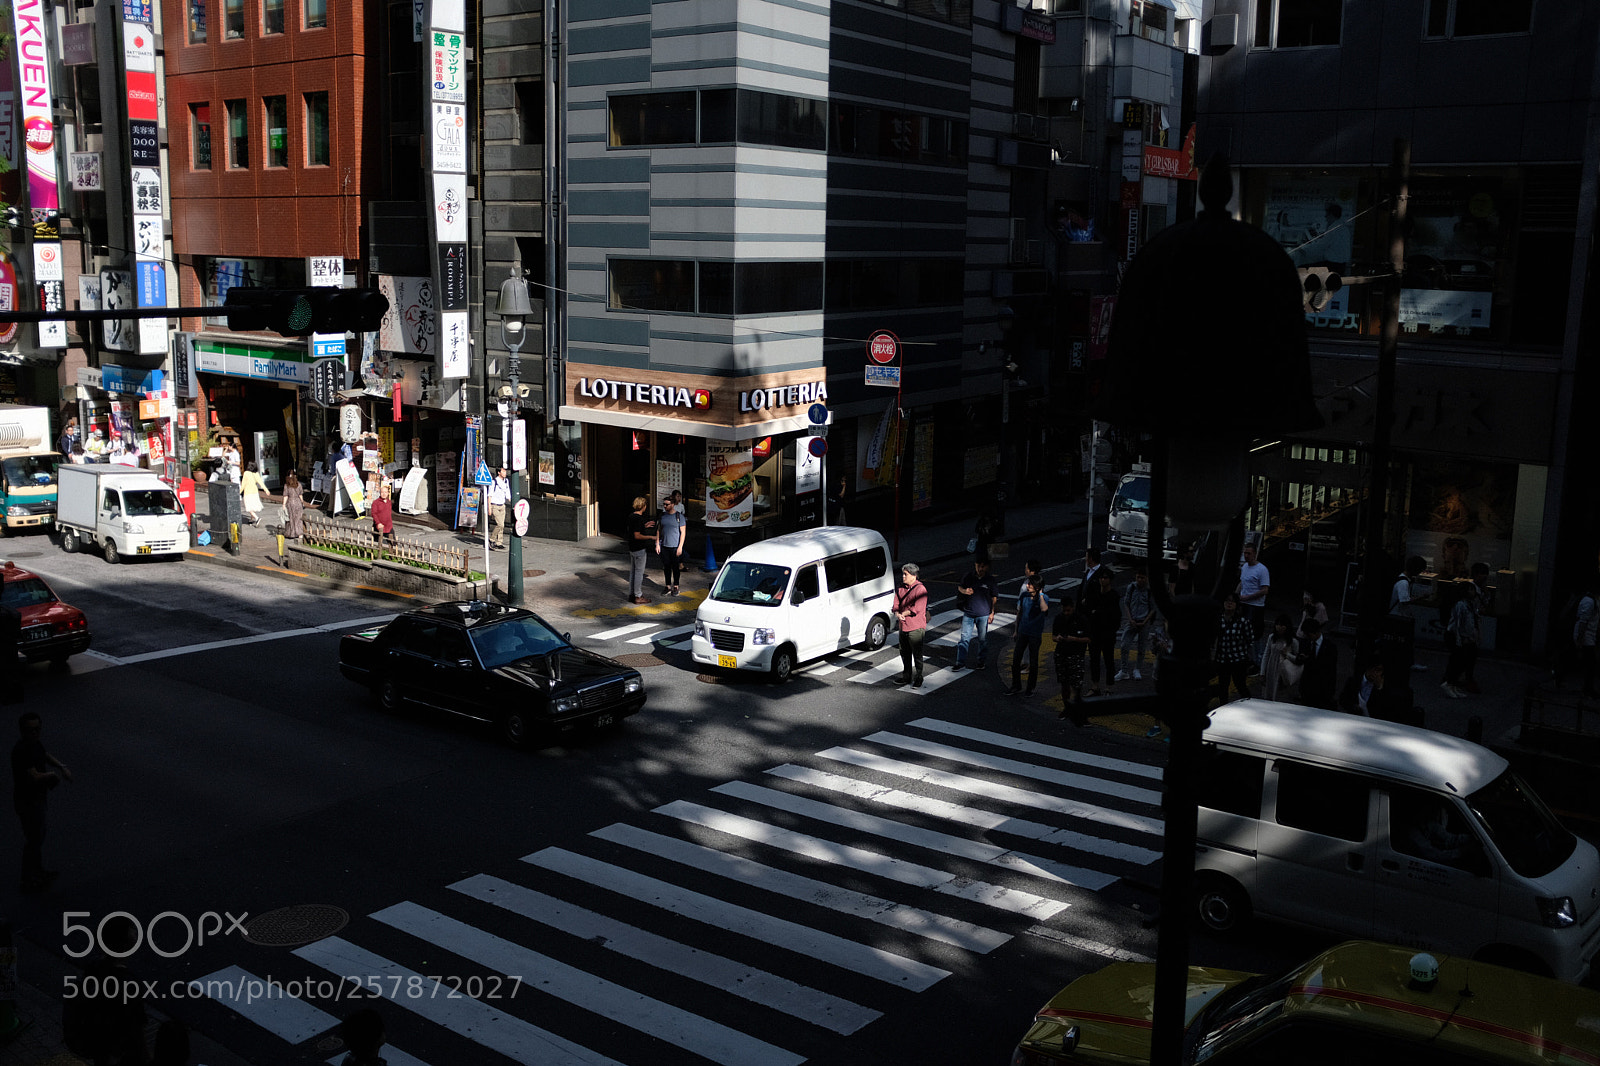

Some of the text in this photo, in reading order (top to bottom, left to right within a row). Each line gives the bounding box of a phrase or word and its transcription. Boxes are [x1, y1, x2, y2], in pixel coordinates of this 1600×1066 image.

[26, 128, 53, 143] 楽園
[132, 125, 155, 135] 美容室
[133, 138, 155, 146] DOO
[133, 150, 147, 158] RE
[138, 221, 151, 253] かいり
[313, 259, 341, 276] 整体
[327, 344, 342, 354] たばこ
[873, 343, 894, 355] 消火栓
[254, 360, 297, 377] FamilyMart
[580, 377, 693, 409] LOTTERIA
[740, 381, 828, 413] LOTTERIA
[519, 503, 526, 517] 7
